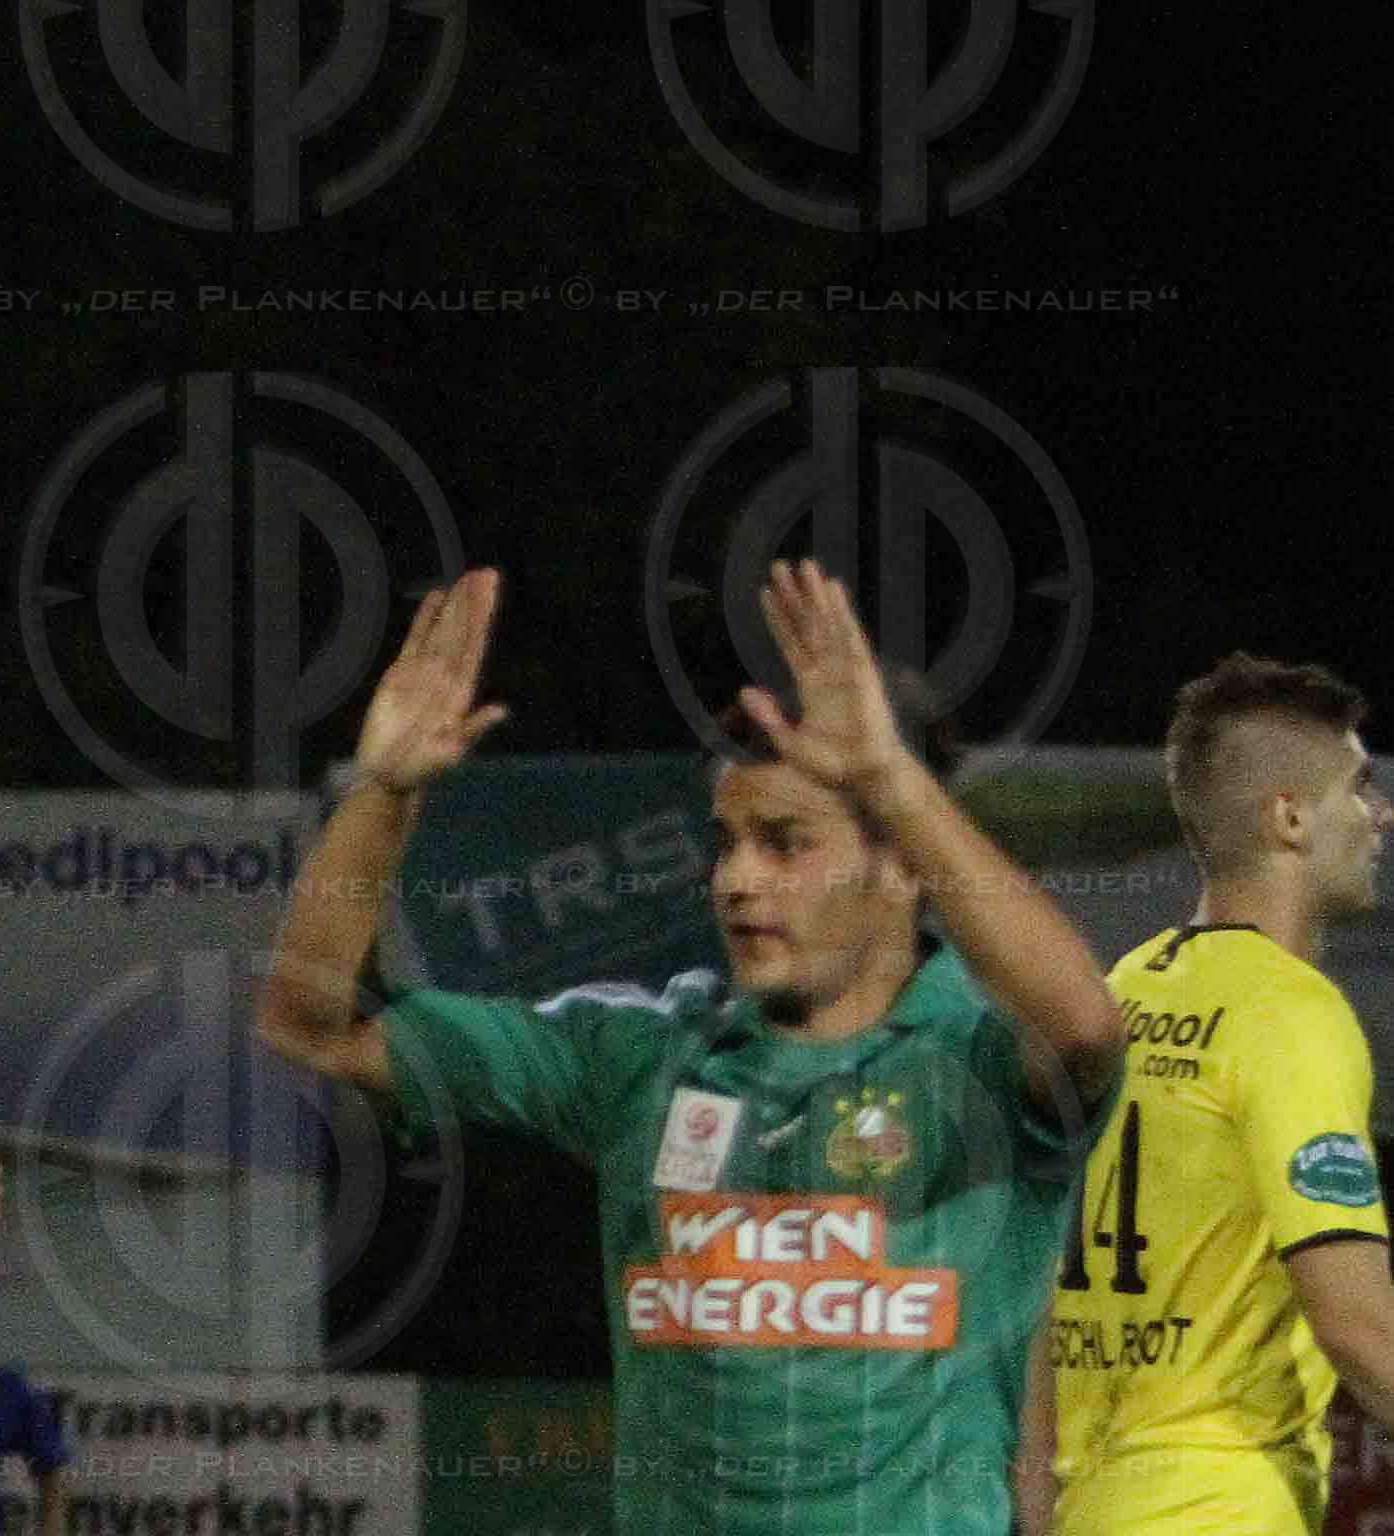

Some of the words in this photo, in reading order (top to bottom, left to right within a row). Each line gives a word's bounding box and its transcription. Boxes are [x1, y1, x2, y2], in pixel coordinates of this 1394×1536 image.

[437, 807, 705, 953] TRS
[669, 1206, 873, 1262] WIEN
[627, 1277, 940, 1336] ENERGIE
